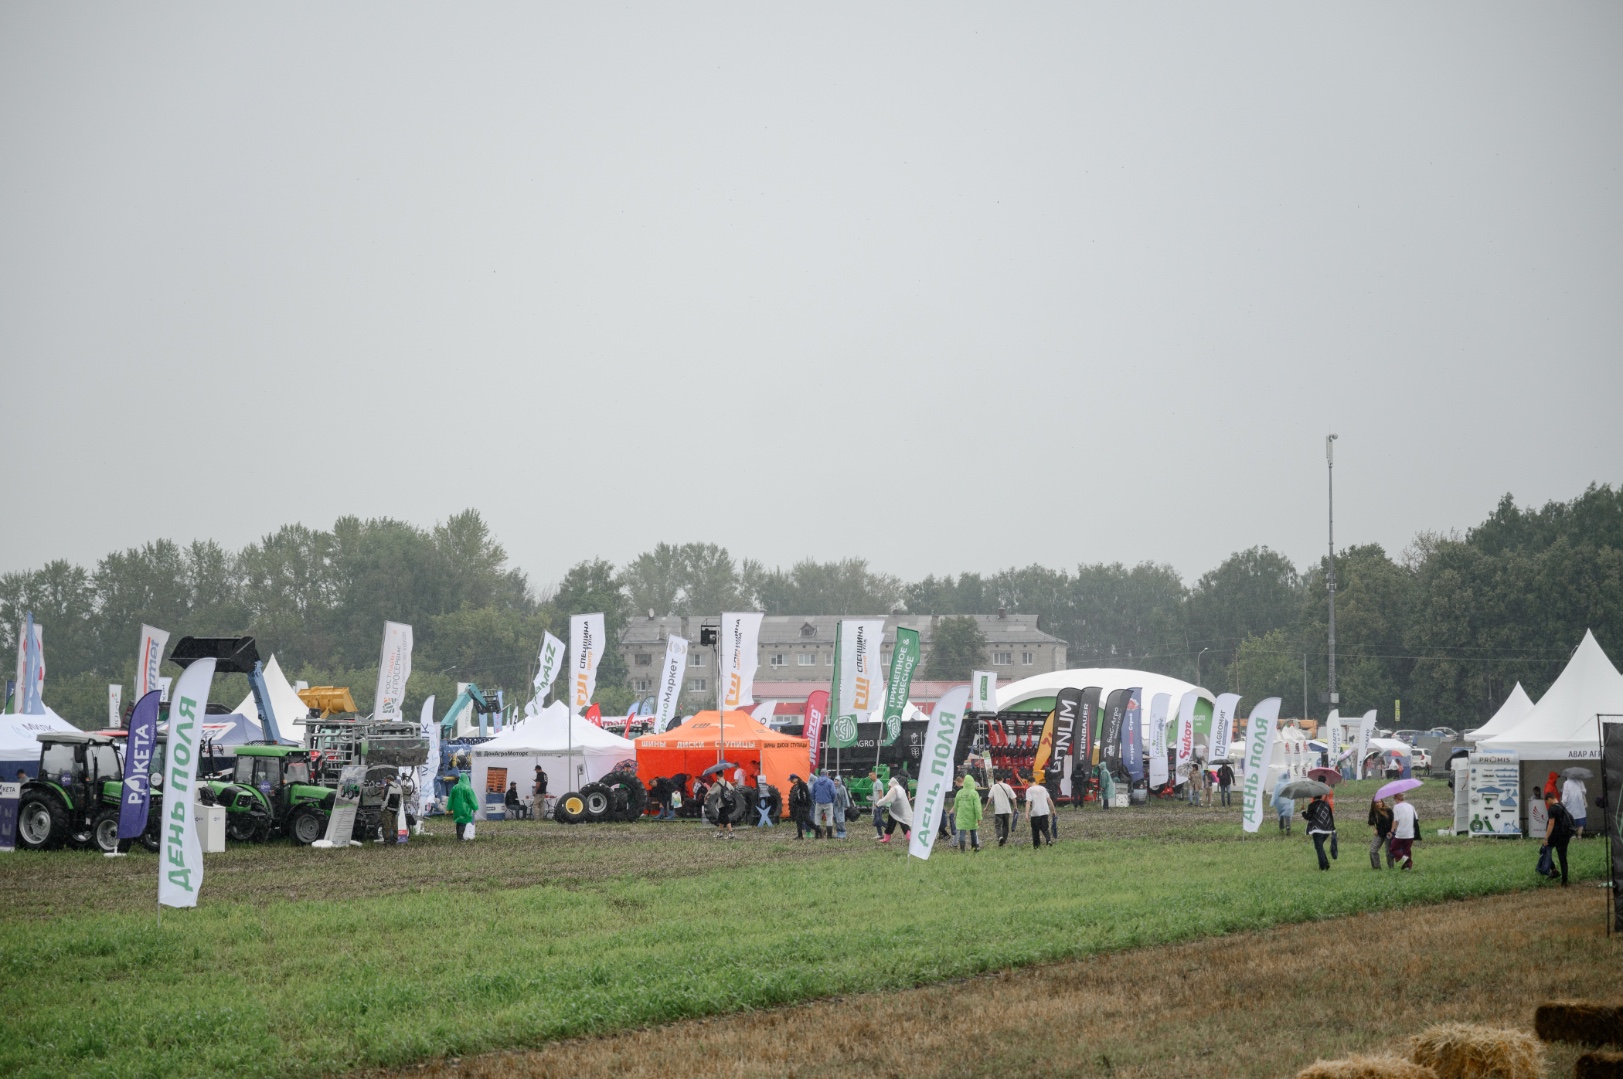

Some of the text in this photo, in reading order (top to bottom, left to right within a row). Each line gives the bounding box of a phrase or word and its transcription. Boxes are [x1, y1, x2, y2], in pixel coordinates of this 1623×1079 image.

[889, 647, 908, 708] ПРИЦЕПНОЕ
[896, 655, 915, 709] НАВЕСНОЕ
[642, 740, 666, 748] ШИНЫ
[1080, 703, 1089, 761] STEINBAUER
[1568, 750, 1588, 758] АВАР
[168, 695, 197, 892] ДЕНЬ ПОЛЯ
[917, 711, 956, 847] ДЕНЬ ПОЛЯ
[1243, 717, 1268, 824] ДЕНЬ ПОЛЯ
